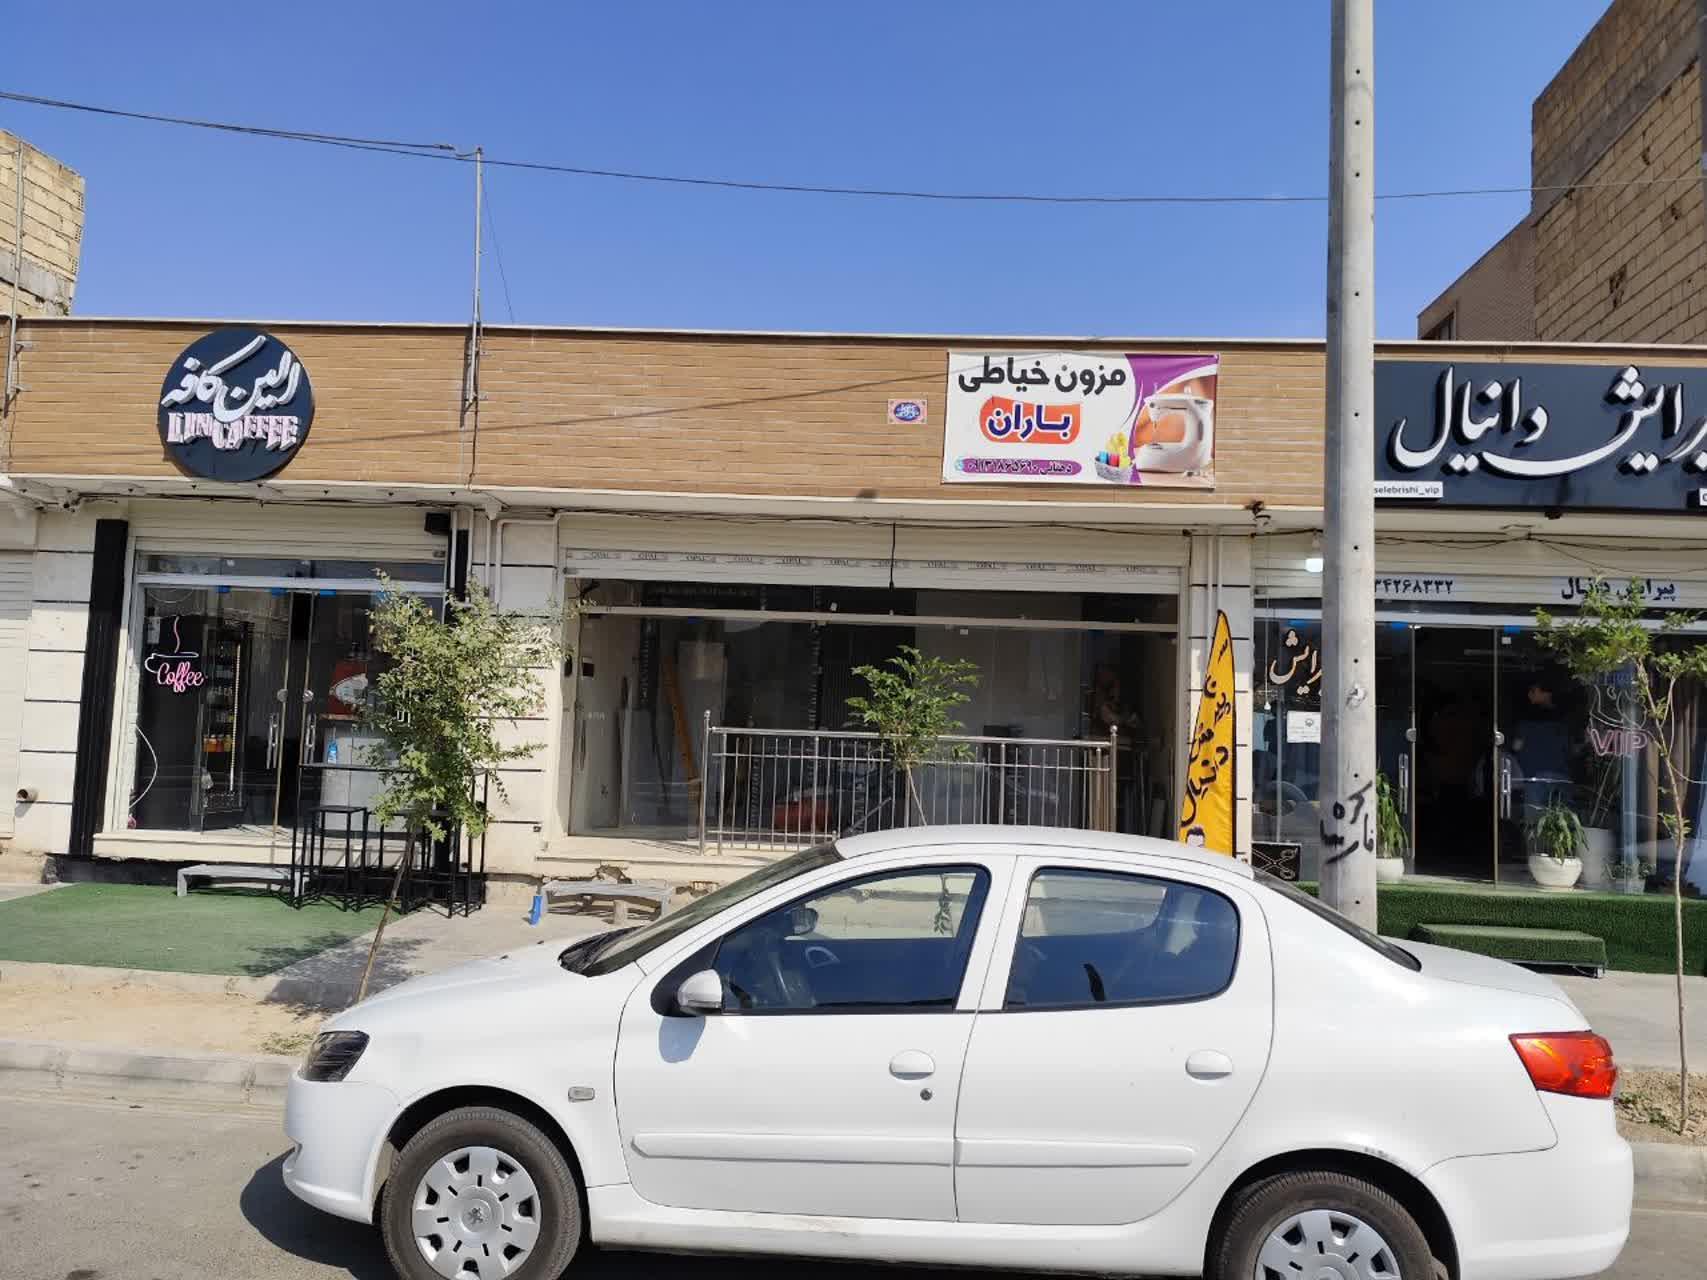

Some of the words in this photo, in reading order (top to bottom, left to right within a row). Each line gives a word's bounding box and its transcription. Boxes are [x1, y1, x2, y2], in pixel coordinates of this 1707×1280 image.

[958, 355, 1050, 393] خیاطی
[1054, 364, 1127, 396] مزون
[987, 403, 1071, 439] باران
[1394, 366, 1548, 472] دانیال
[1482, 367, 1707, 476] رایش
[157, 661, 205, 693] Coffee
[1590, 728, 1648, 757] VIP
